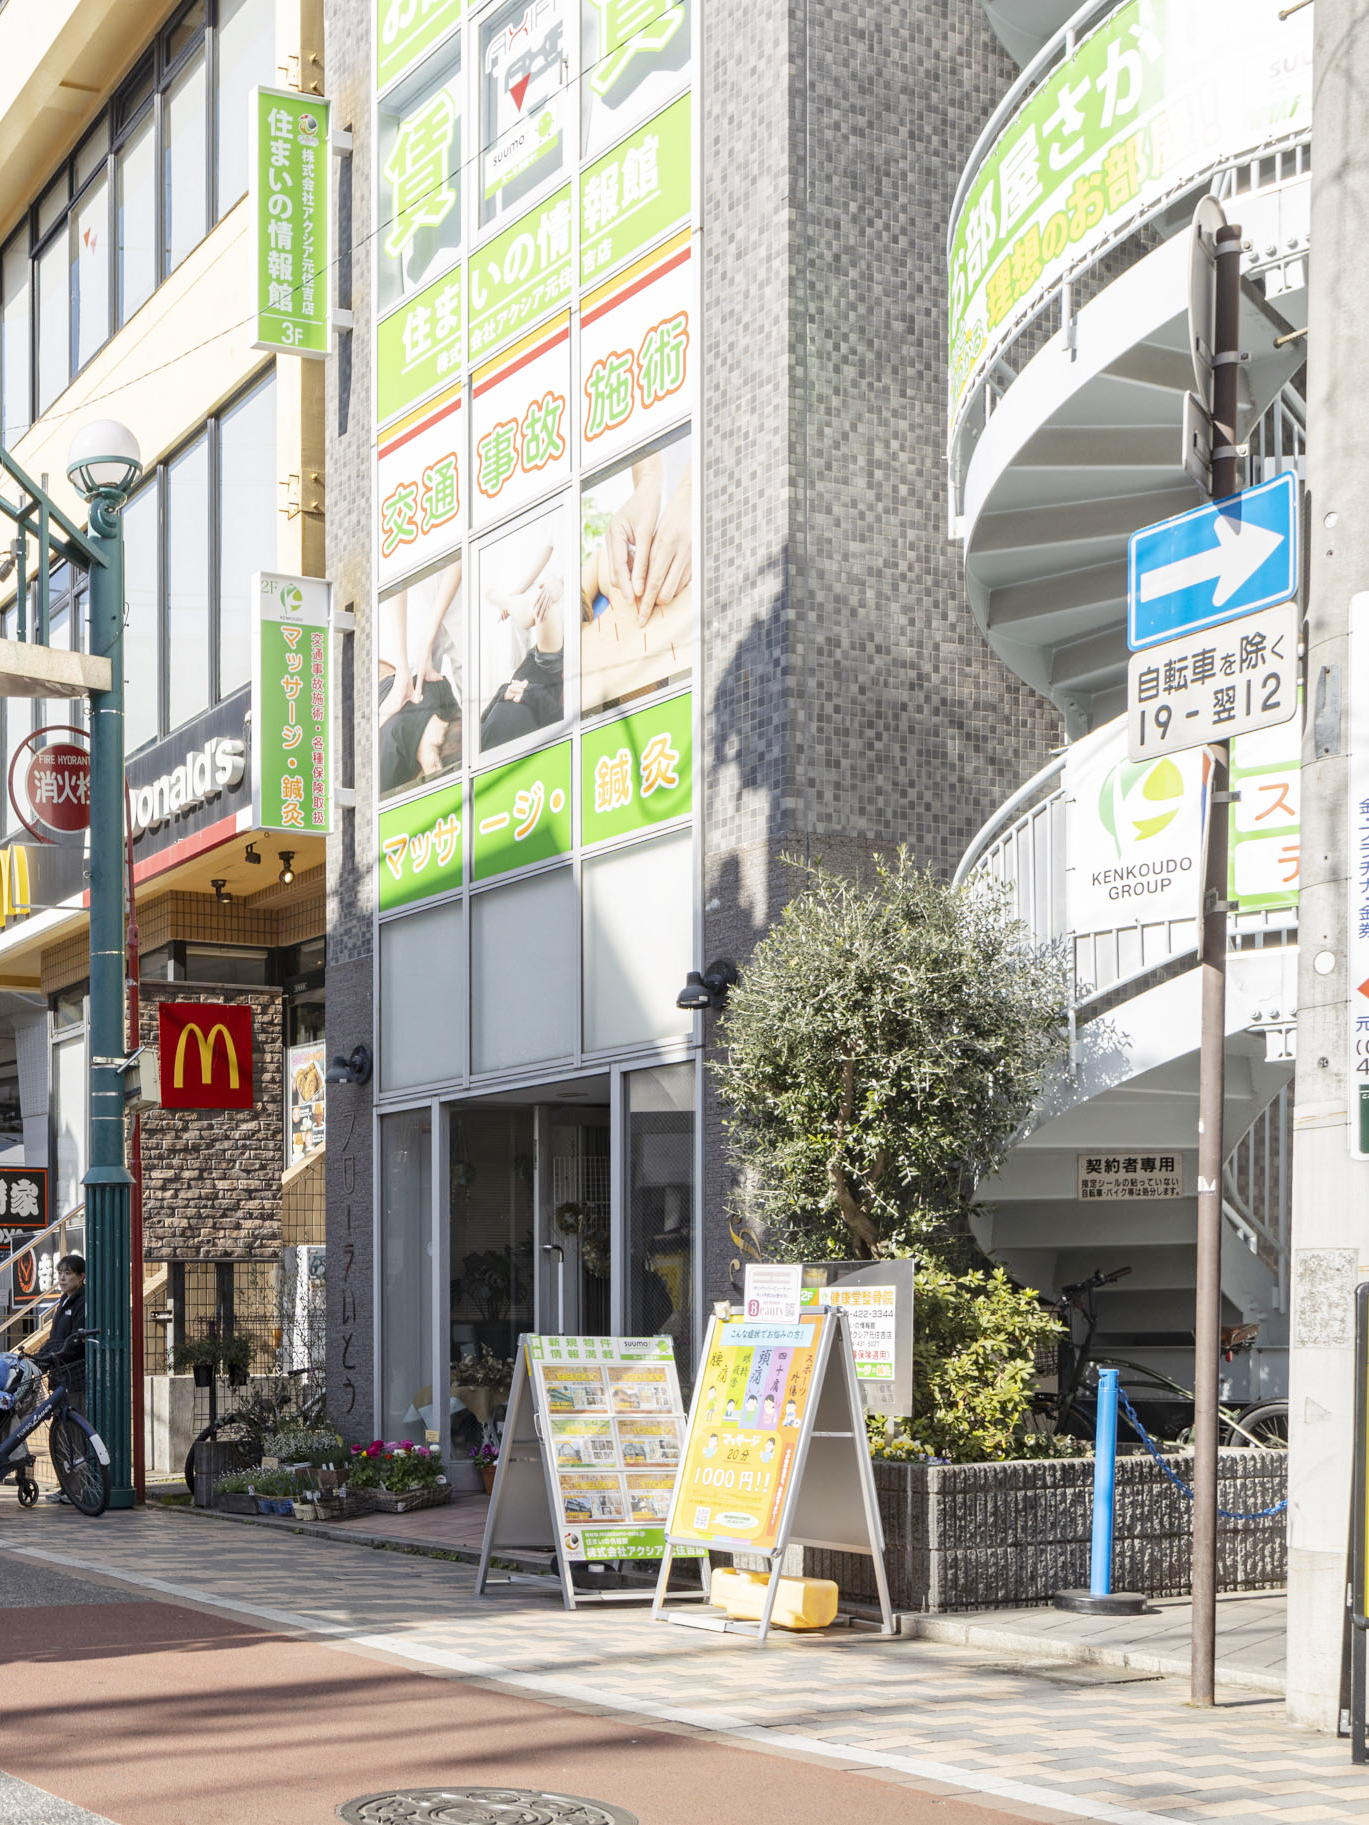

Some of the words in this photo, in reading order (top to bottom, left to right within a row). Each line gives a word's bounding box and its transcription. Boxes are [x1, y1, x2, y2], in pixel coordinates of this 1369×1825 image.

[267, 107, 294, 314] 住まいの情報館
[301, 148, 315, 316] 株式会社アクシア元住吉店
[281, 322, 304, 346] 3F
[261, 579, 279, 596] 2F
[1139, 632, 1284, 703] 自転車を除く
[281, 626, 305, 828] マッサージ・鍼灸
[1140, 672, 1281, 746] 19-翌12
[310, 632, 325, 825] 交通事故施術・各種保険取扱
[38, 754, 56, 766] FIRE
[131, 737, 245, 831] onald's
[1092, 857, 1193, 886] KENKOUDO
[1108, 877, 1172, 900] GROUP
[1086, 1157, 1175, 1174] 契約者専用
[801, 1290, 814, 1301] 2F
[831, 1290, 895, 1306] 健康堂整骨院
[750, 1349, 773, 1385] 頭痛
[771, 1352, 788, 1393] 四十肩
